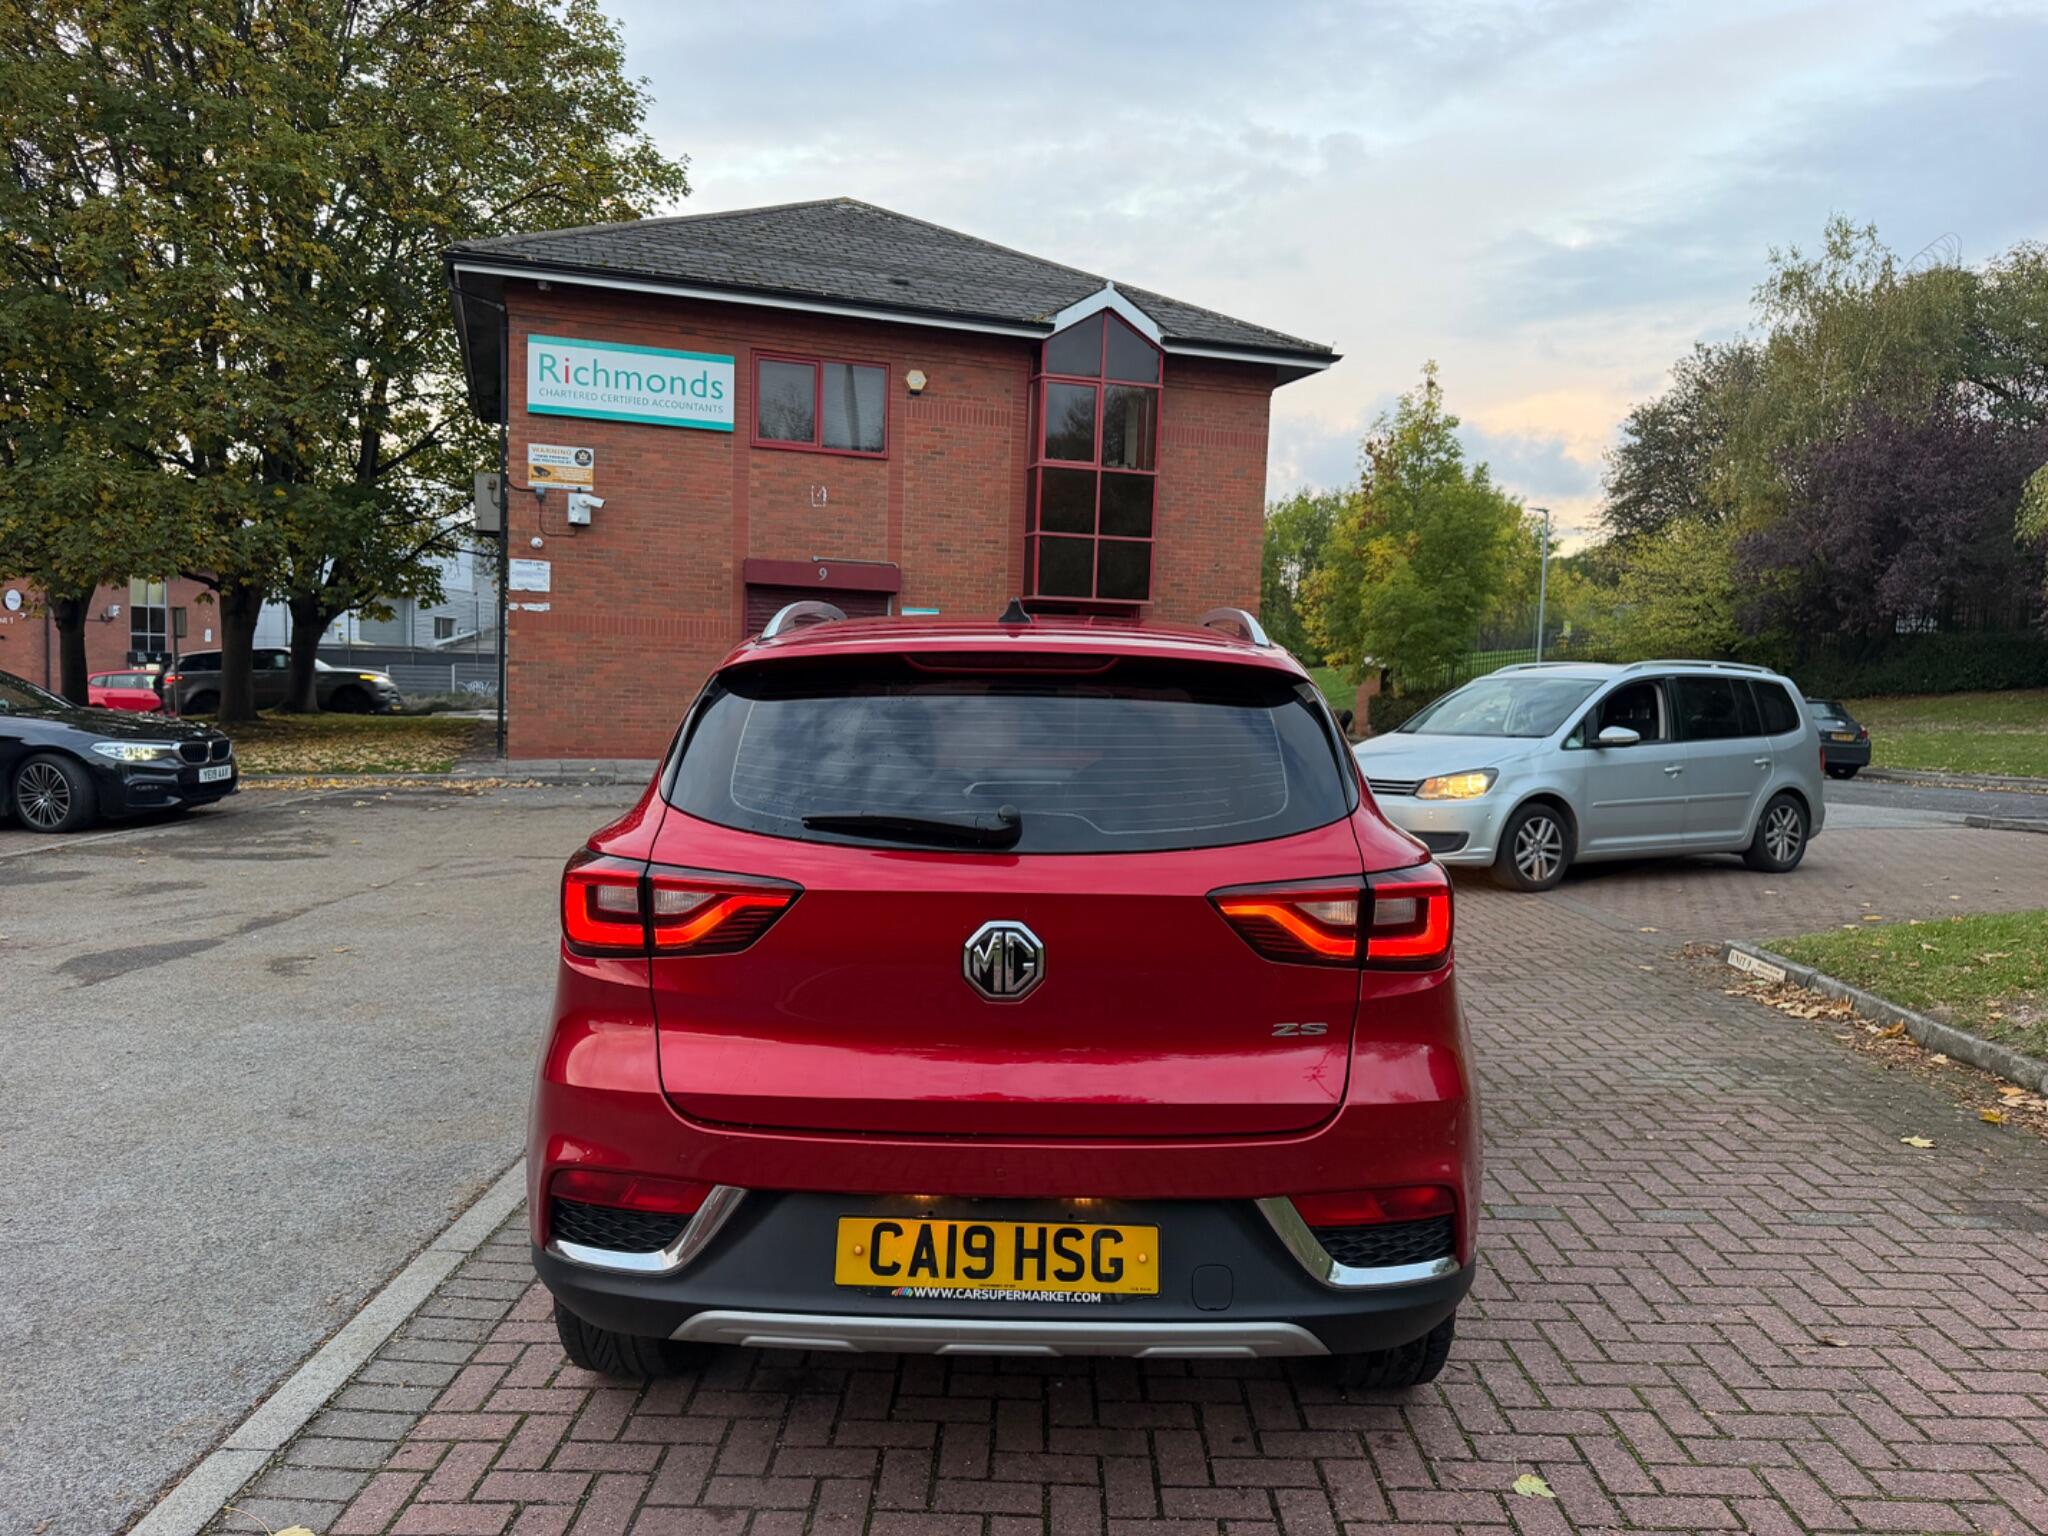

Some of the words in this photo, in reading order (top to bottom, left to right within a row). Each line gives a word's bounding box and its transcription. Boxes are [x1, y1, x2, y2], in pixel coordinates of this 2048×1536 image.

[539, 353, 723, 399] Richmonds
[538, 387, 598, 401] CHARTERED
[600, 393, 649, 406] CERTIFIED
[652, 398, 724, 413] ACCOUNTANTS
[819, 567, 828, 581] 9
[971, 930, 1036, 990] MG
[1271, 1022, 1328, 1037] ZS
[869, 1222, 996, 1280] CA19
[1013, 1226, 1124, 1283] HSG
[914, 1286, 1101, 1304] WWW.CARSUPERMARKET.COM
